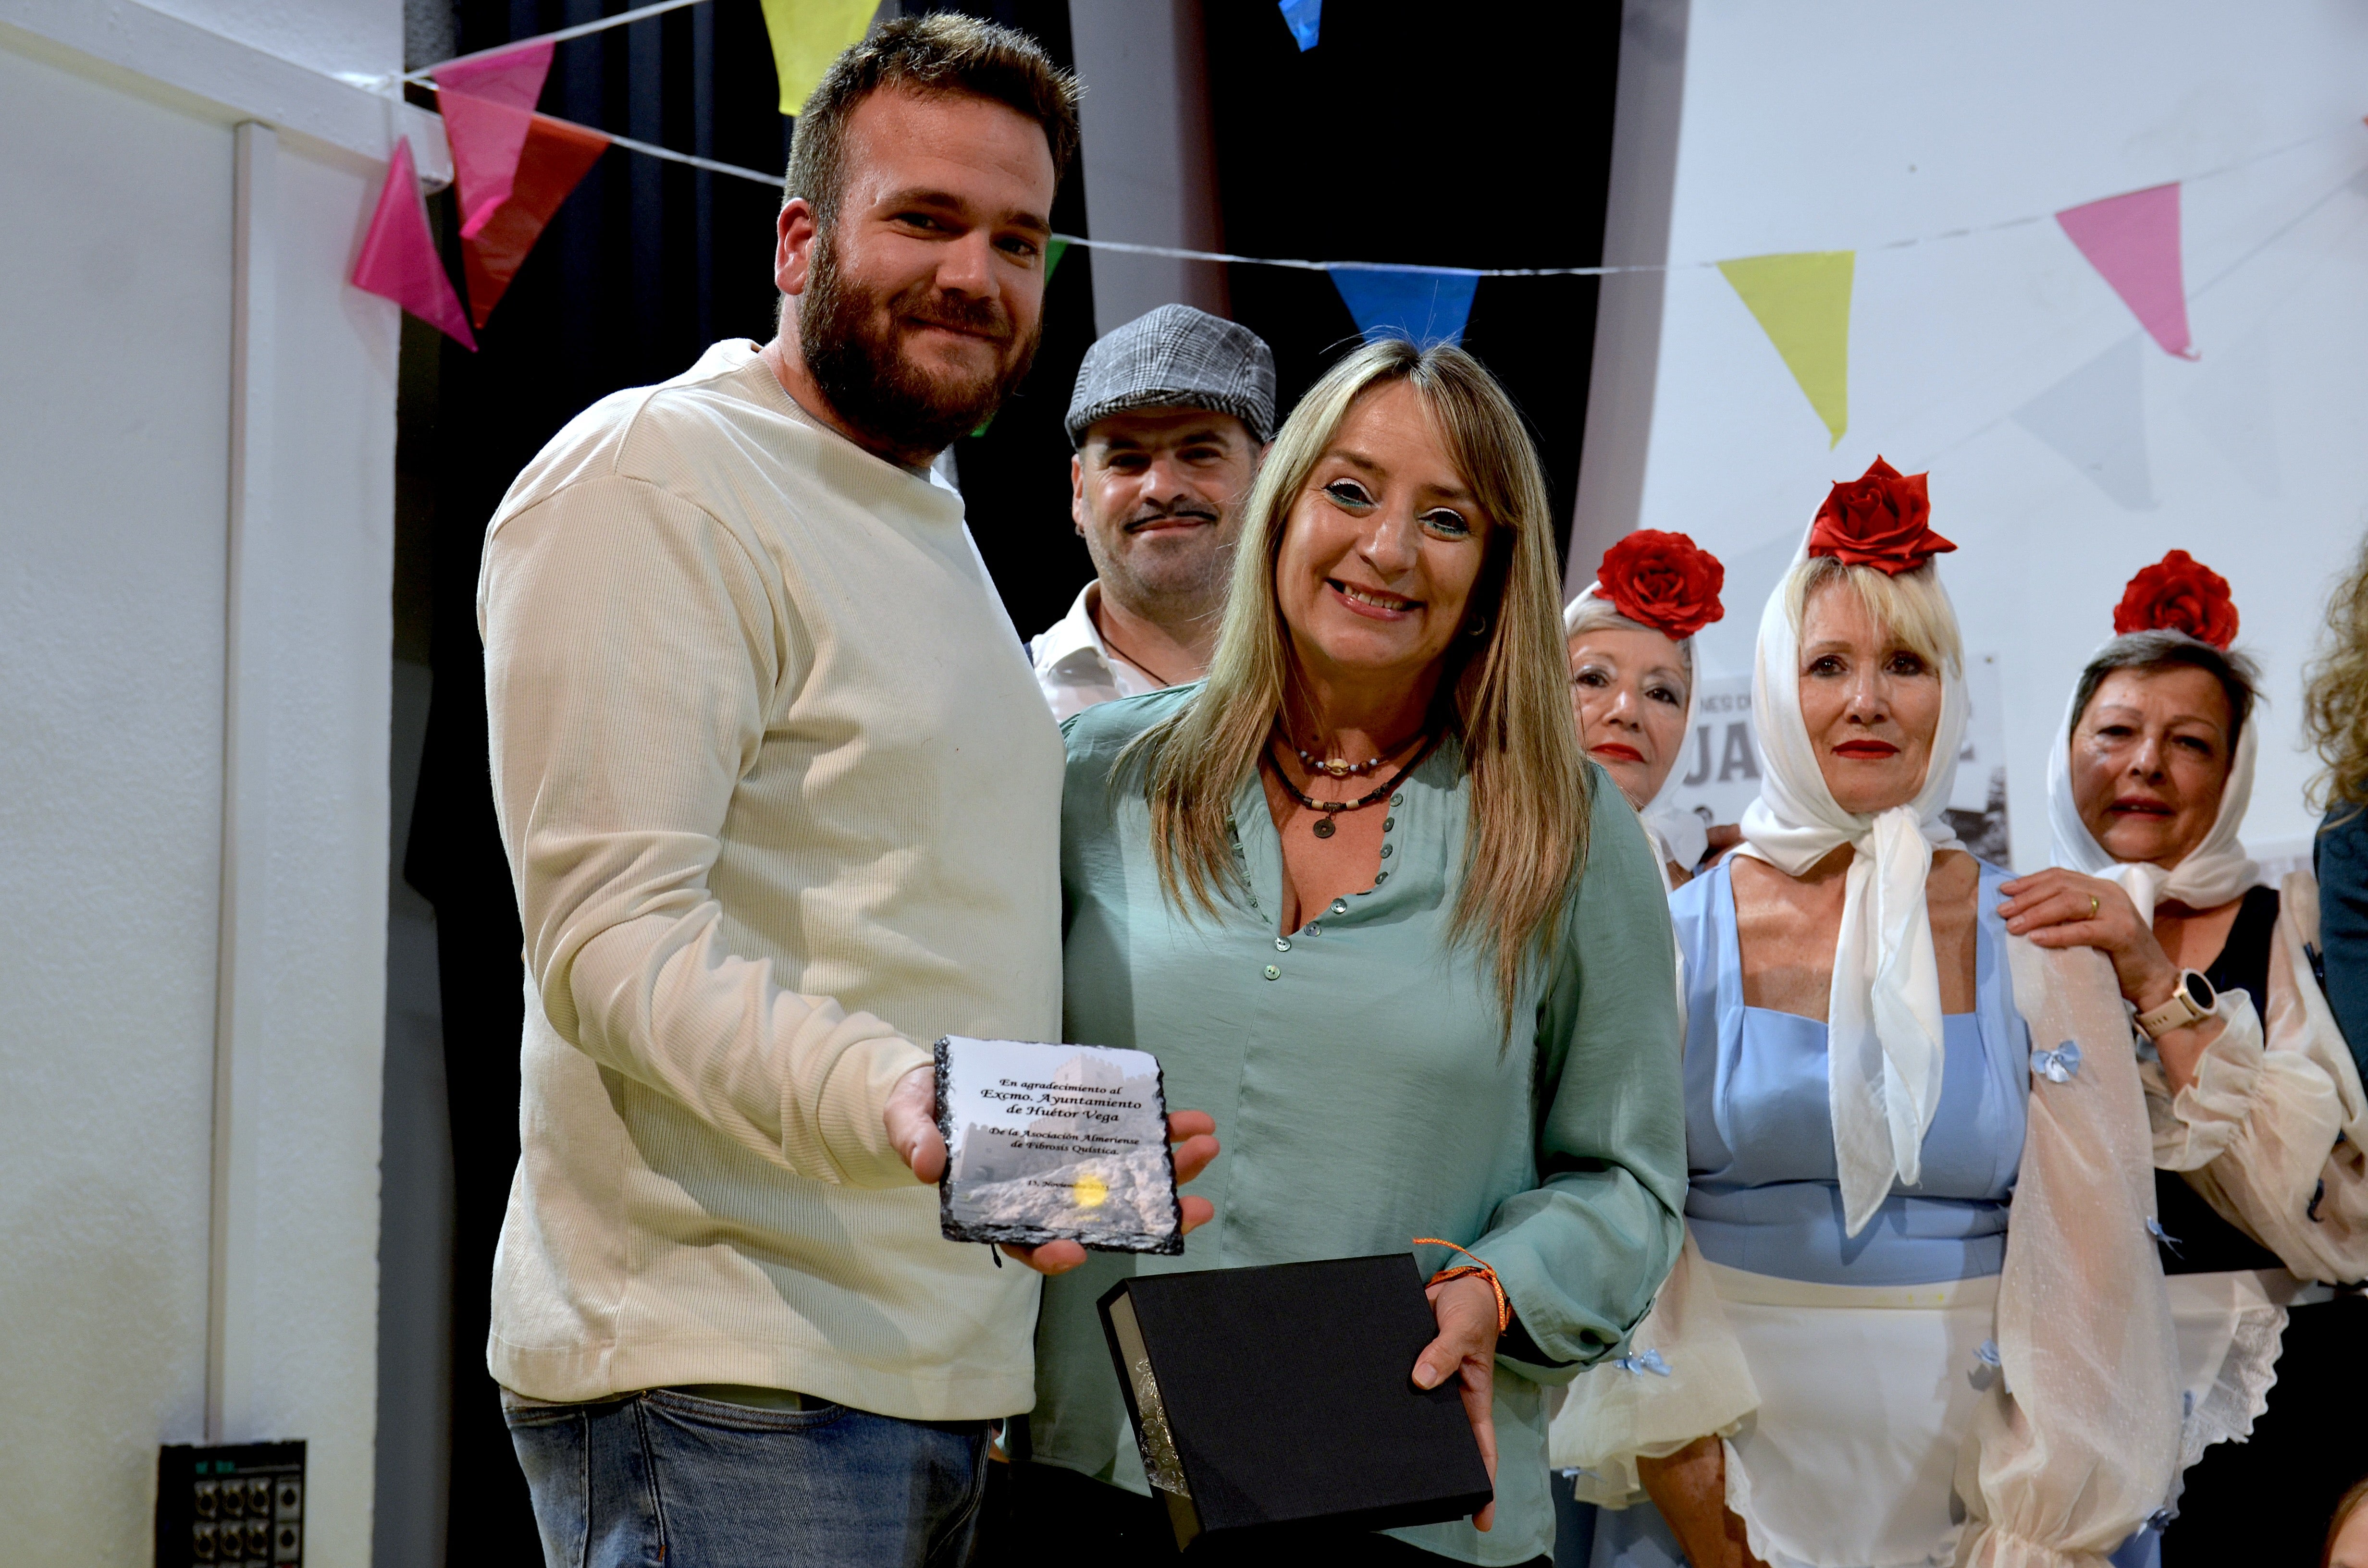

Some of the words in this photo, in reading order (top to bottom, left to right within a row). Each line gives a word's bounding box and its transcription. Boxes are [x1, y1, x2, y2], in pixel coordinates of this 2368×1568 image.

[999, 1078, 1017, 1087] En
[1021, 1081, 1107, 1094] agradecimiento
[981, 1089, 1033, 1101] Excmo.
[1036, 1093, 1142, 1109] Ayuntamiento
[1006, 1104, 1022, 1114] de
[1026, 1106, 1079, 1117] Huétor
[1083, 1110, 1120, 1124] Vega
[989, 1127, 1005, 1135] De
[1020, 1130, 1078, 1140] Asociación
[1081, 1134, 1139, 1145] Almeriense
[1011, 1140, 1023, 1148] de
[1026, 1141, 1069, 1152] Fibrosis
